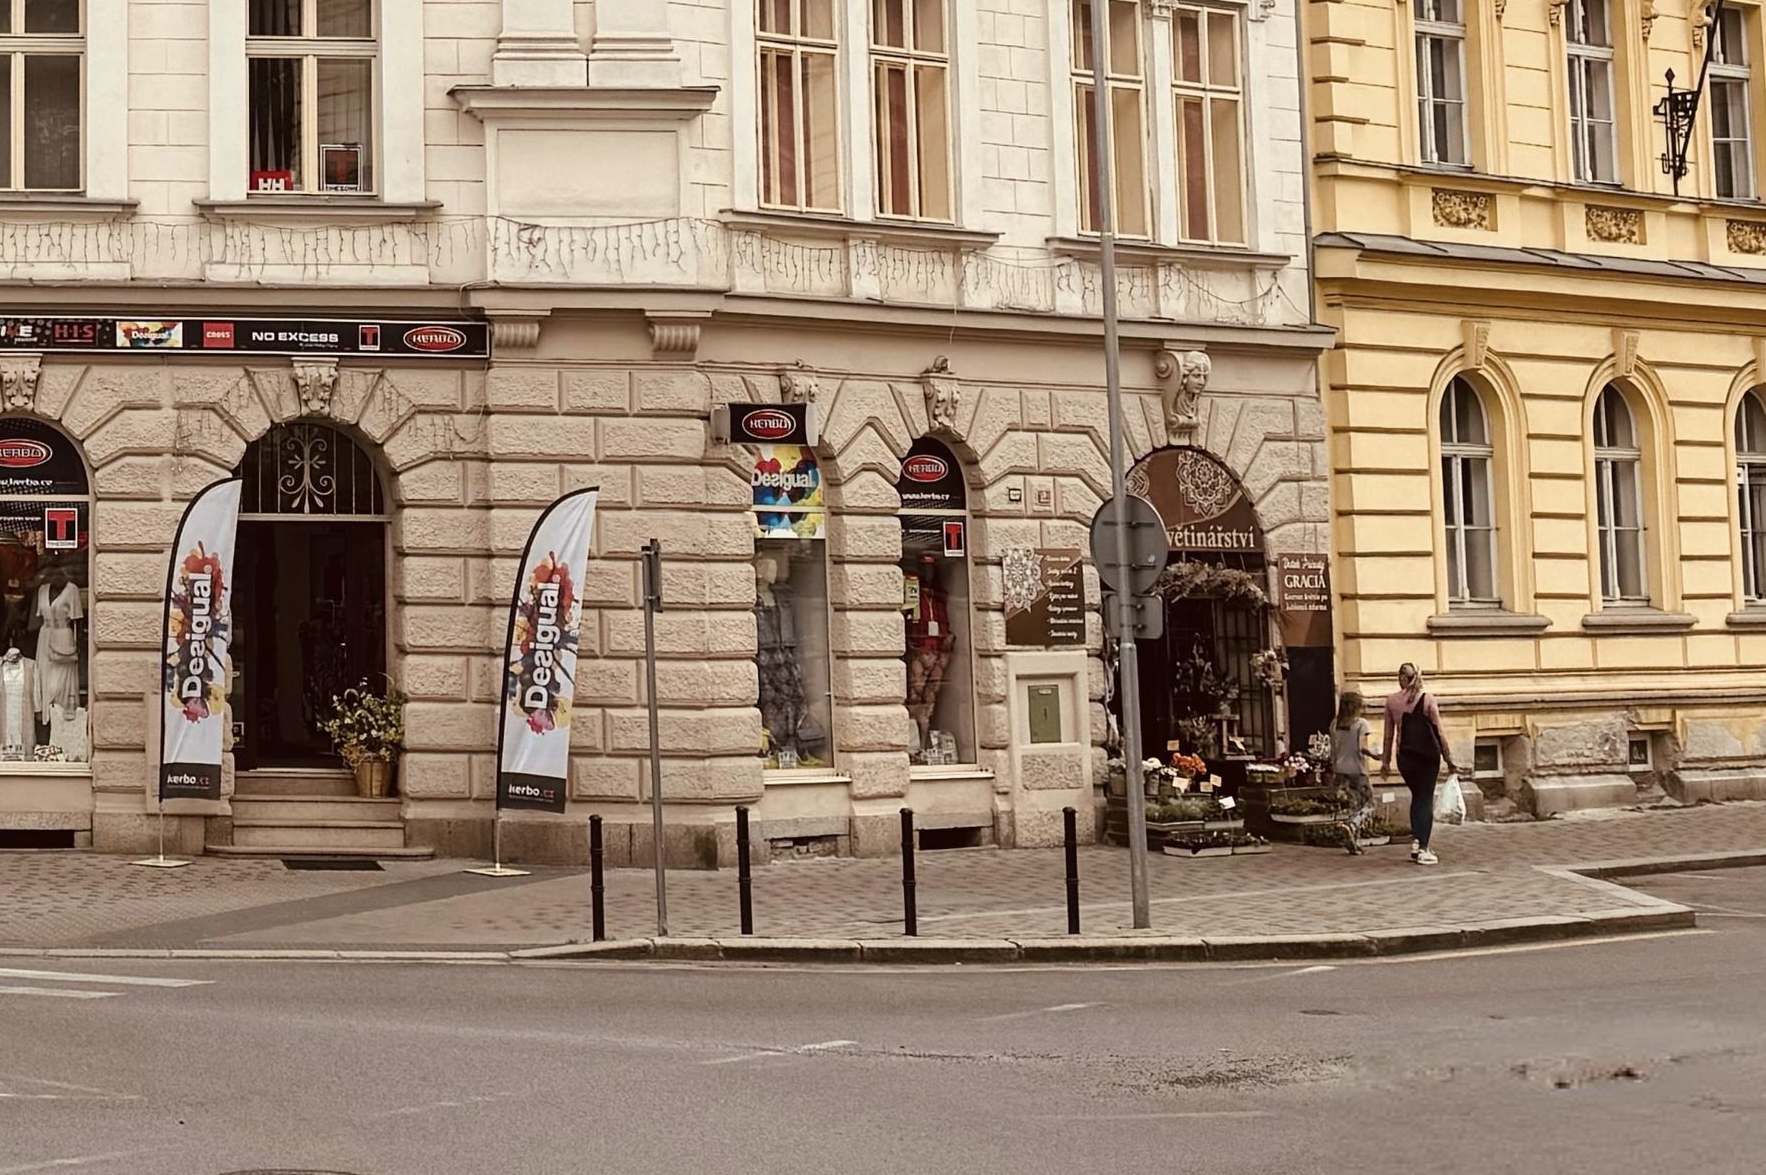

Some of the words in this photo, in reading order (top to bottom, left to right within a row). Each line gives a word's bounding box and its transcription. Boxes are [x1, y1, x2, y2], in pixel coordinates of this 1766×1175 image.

[252, 331, 275, 341] NO
[278, 332, 339, 343] EXCESS
[1166, 525, 1256, 549] větinářství
